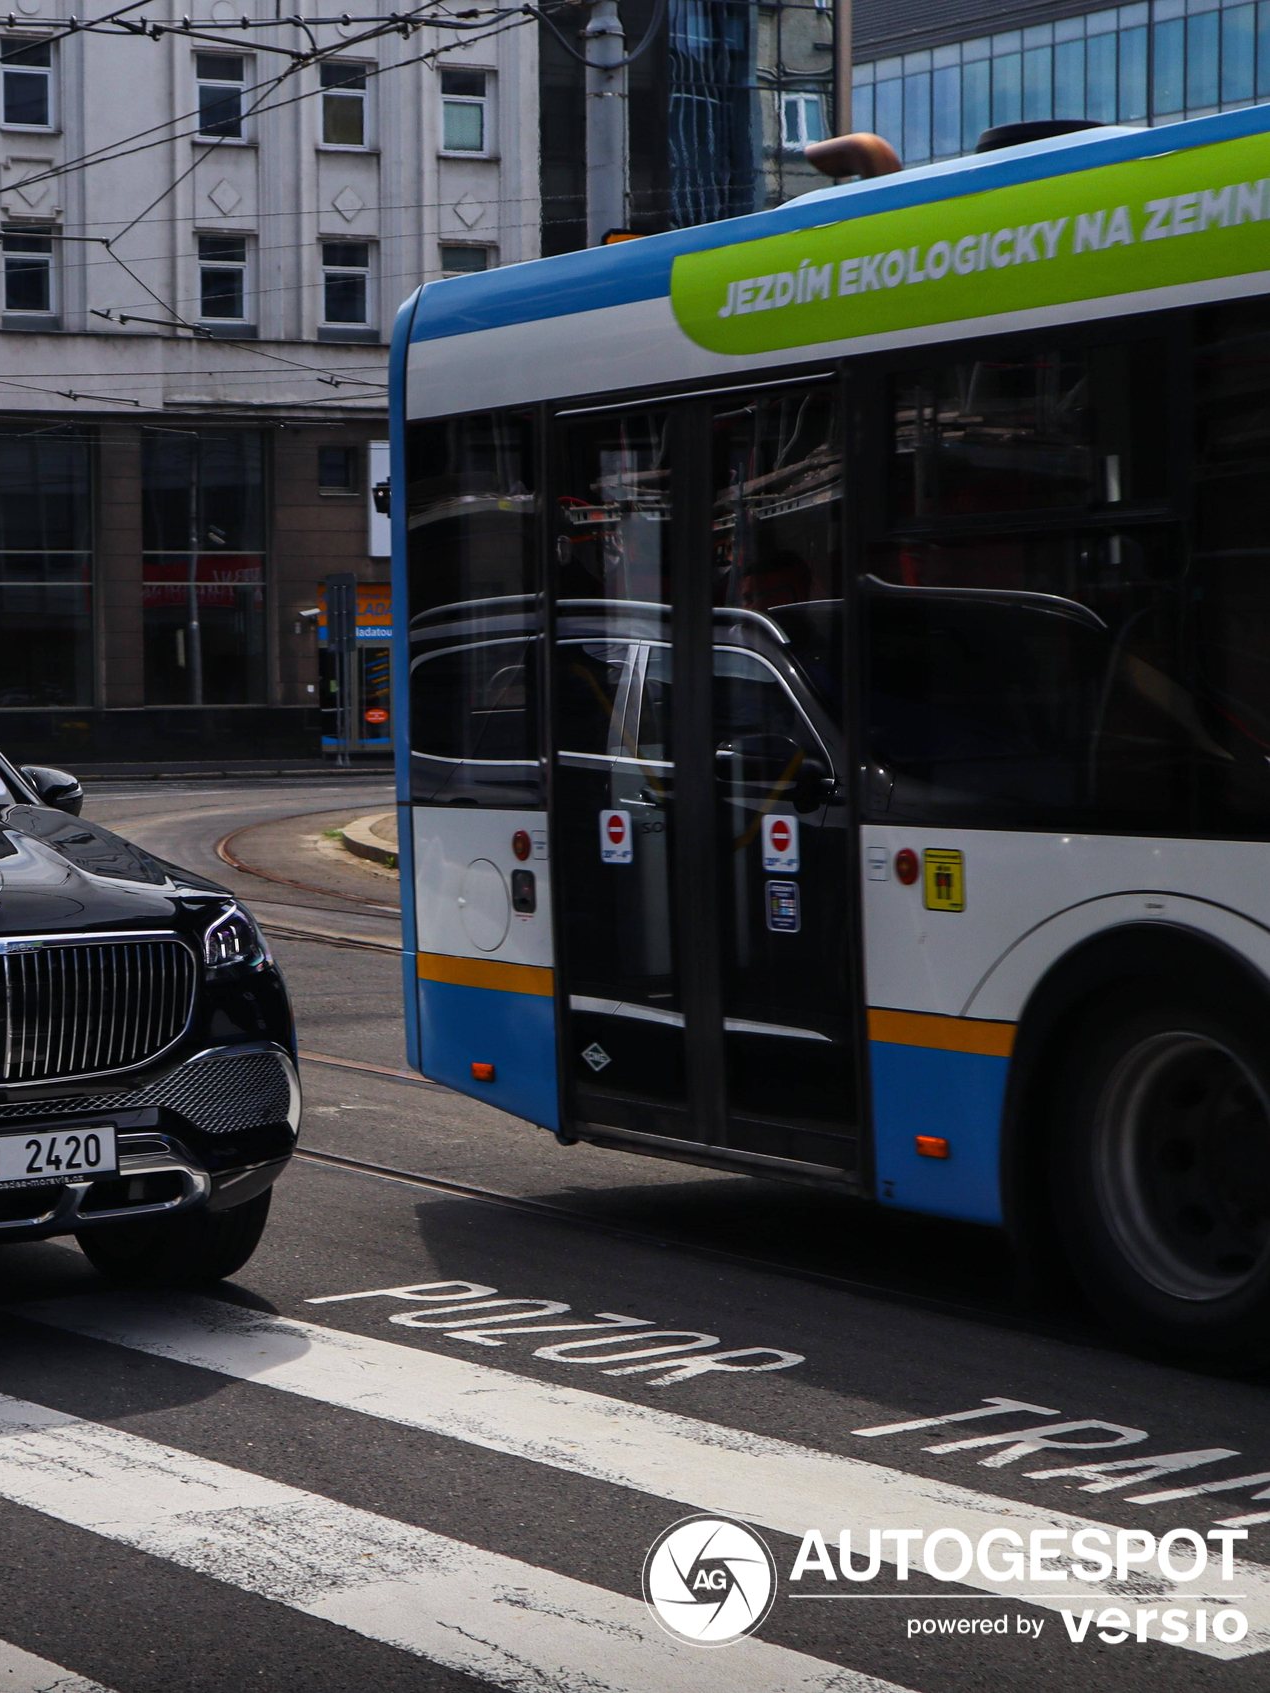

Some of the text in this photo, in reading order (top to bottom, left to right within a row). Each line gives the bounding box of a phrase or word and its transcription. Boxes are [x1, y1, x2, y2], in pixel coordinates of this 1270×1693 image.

[718, 176, 1270, 318] JEZDÍM EKOLOGICKY NA ZEMN
[356, 627, 392, 637] ladatou
[25, 1133, 101, 1174] 2420
[303, 1280, 806, 1387] POZOR
